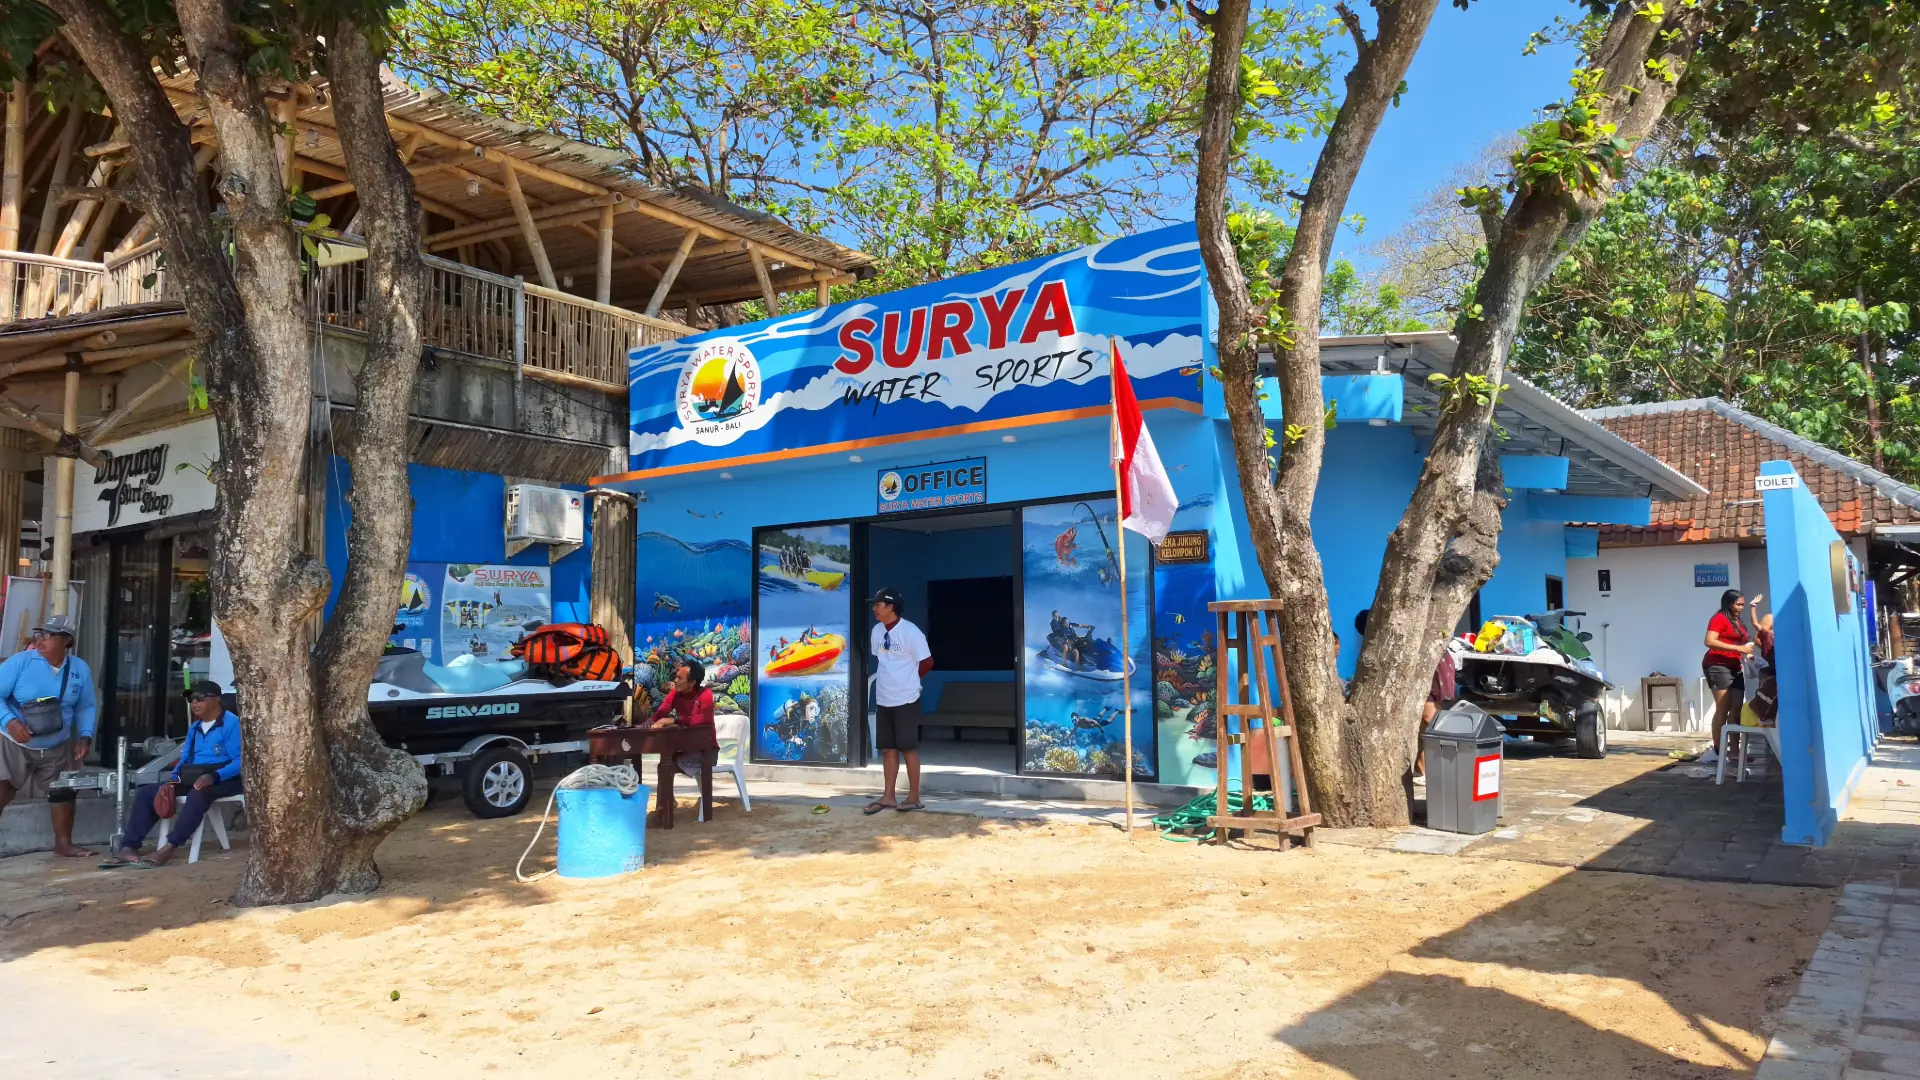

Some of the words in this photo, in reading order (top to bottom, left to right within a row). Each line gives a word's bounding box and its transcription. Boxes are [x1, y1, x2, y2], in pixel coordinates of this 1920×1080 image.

[833, 280, 1077, 375] SURYA
[680, 371, 693, 420] SURYA
[692, 346, 734, 368] WATER
[737, 352, 756, 411] SPORTS
[844, 371, 942, 418] WATER
[973, 350, 1094, 391] SPORTS
[695, 424, 720, 435] SANUR
[725, 422, 741, 431] BALI
[904, 466, 983, 493] OFFICE
[1757, 477, 1795, 487] TOILET
[119, 479, 147, 505] Surf
[140, 491, 173, 515] Shop
[880, 501, 909, 512] SURYA
[910, 496, 942, 508] WATER
[944, 492, 984, 504] SPORTS
[1177, 536, 1202, 546] JUKUNG
[1194, 547, 1201, 556] IV
[474, 569, 542, 582] SURYA
